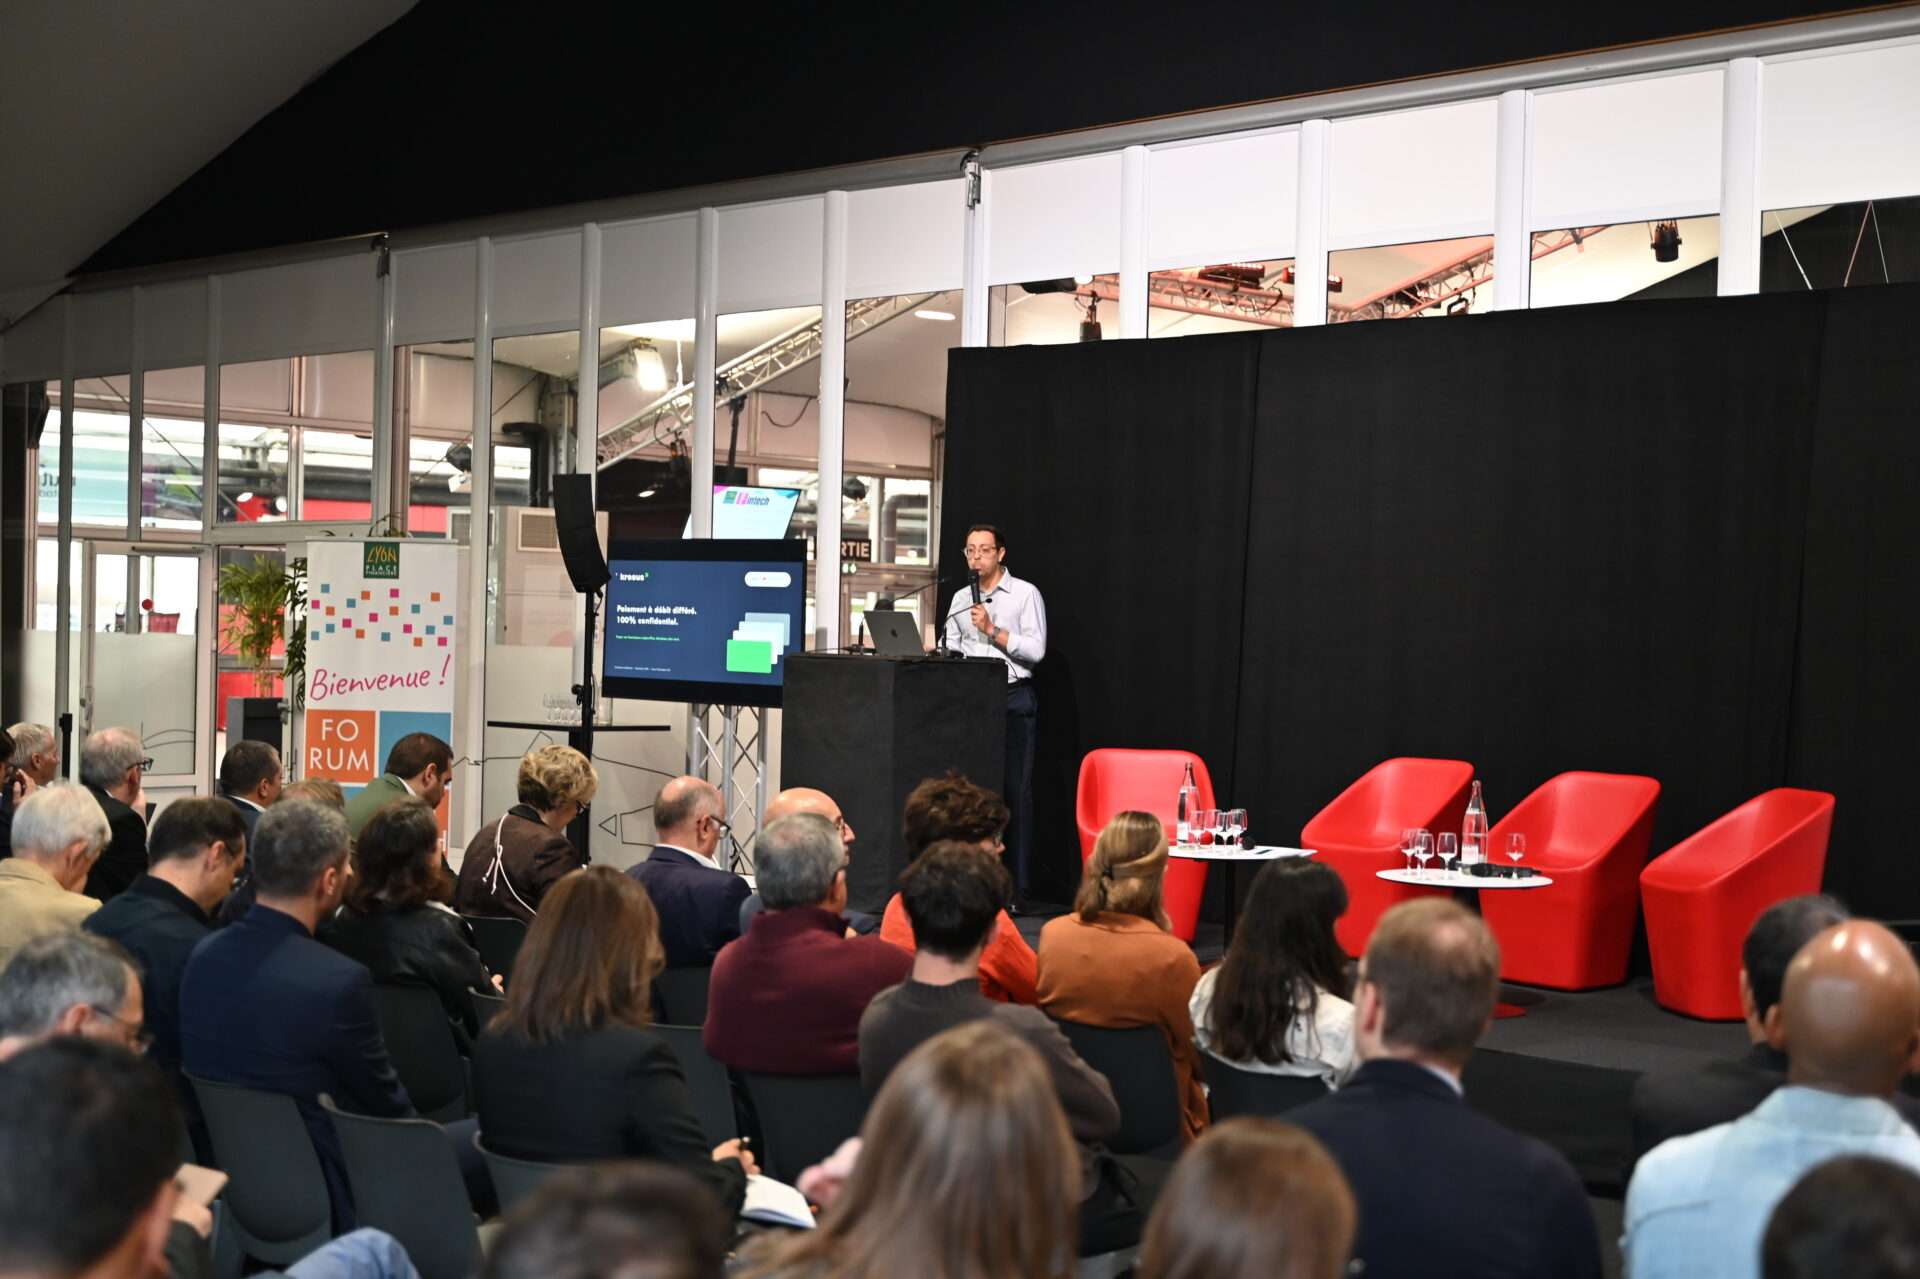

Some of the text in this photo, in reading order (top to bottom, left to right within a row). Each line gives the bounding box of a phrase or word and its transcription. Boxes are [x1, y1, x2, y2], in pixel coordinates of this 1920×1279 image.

[368, 546, 397, 563] LYON
[841, 541, 869, 557] RTIE
[617, 604, 647, 613] Paiement
[654, 605, 671, 614] débit
[672, 606, 697, 615] différé.
[617, 616, 679, 626] 100% confidentiel.
[310, 668, 430, 701] Bienvenue
[322, 719, 359, 742] FO
[310, 747, 369, 771] RUM
